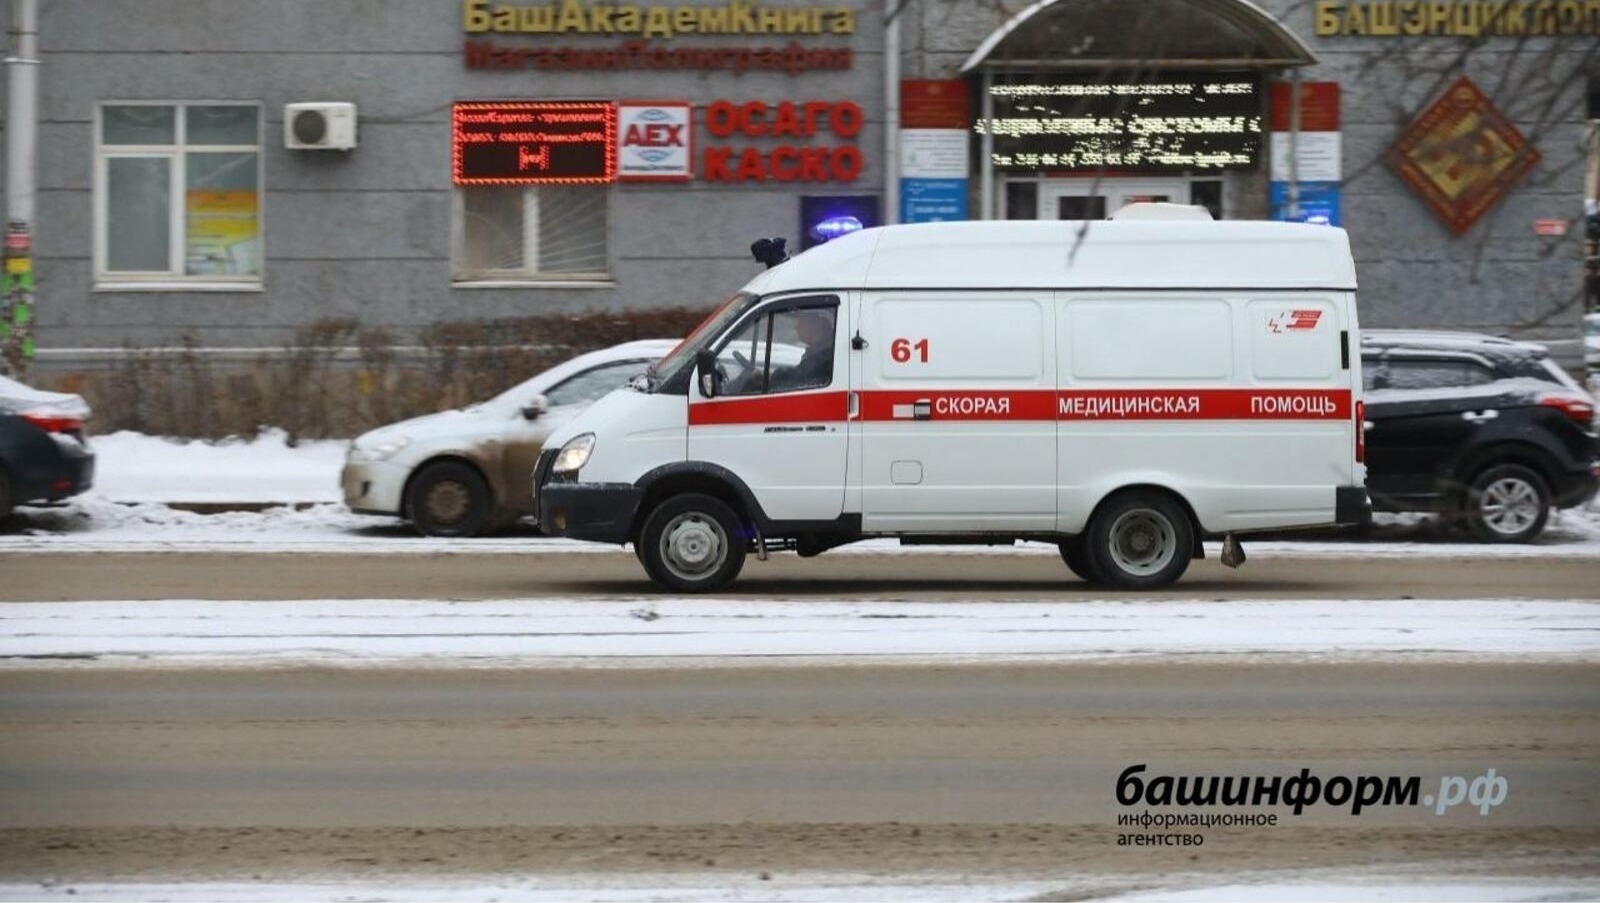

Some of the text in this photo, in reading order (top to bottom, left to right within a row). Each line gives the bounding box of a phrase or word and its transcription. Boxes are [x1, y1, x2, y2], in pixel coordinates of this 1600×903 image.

[464, 0, 855, 38] БашАкадемКнига
[706, 101, 863, 138] ОСАГО
[704, 146, 863, 182] КАСКО
[890, 338, 929, 363] 61
[935, 396, 1337, 416] СКОРАЯ МЕДИЦИНСКАЯ ПОМОЩЬ
